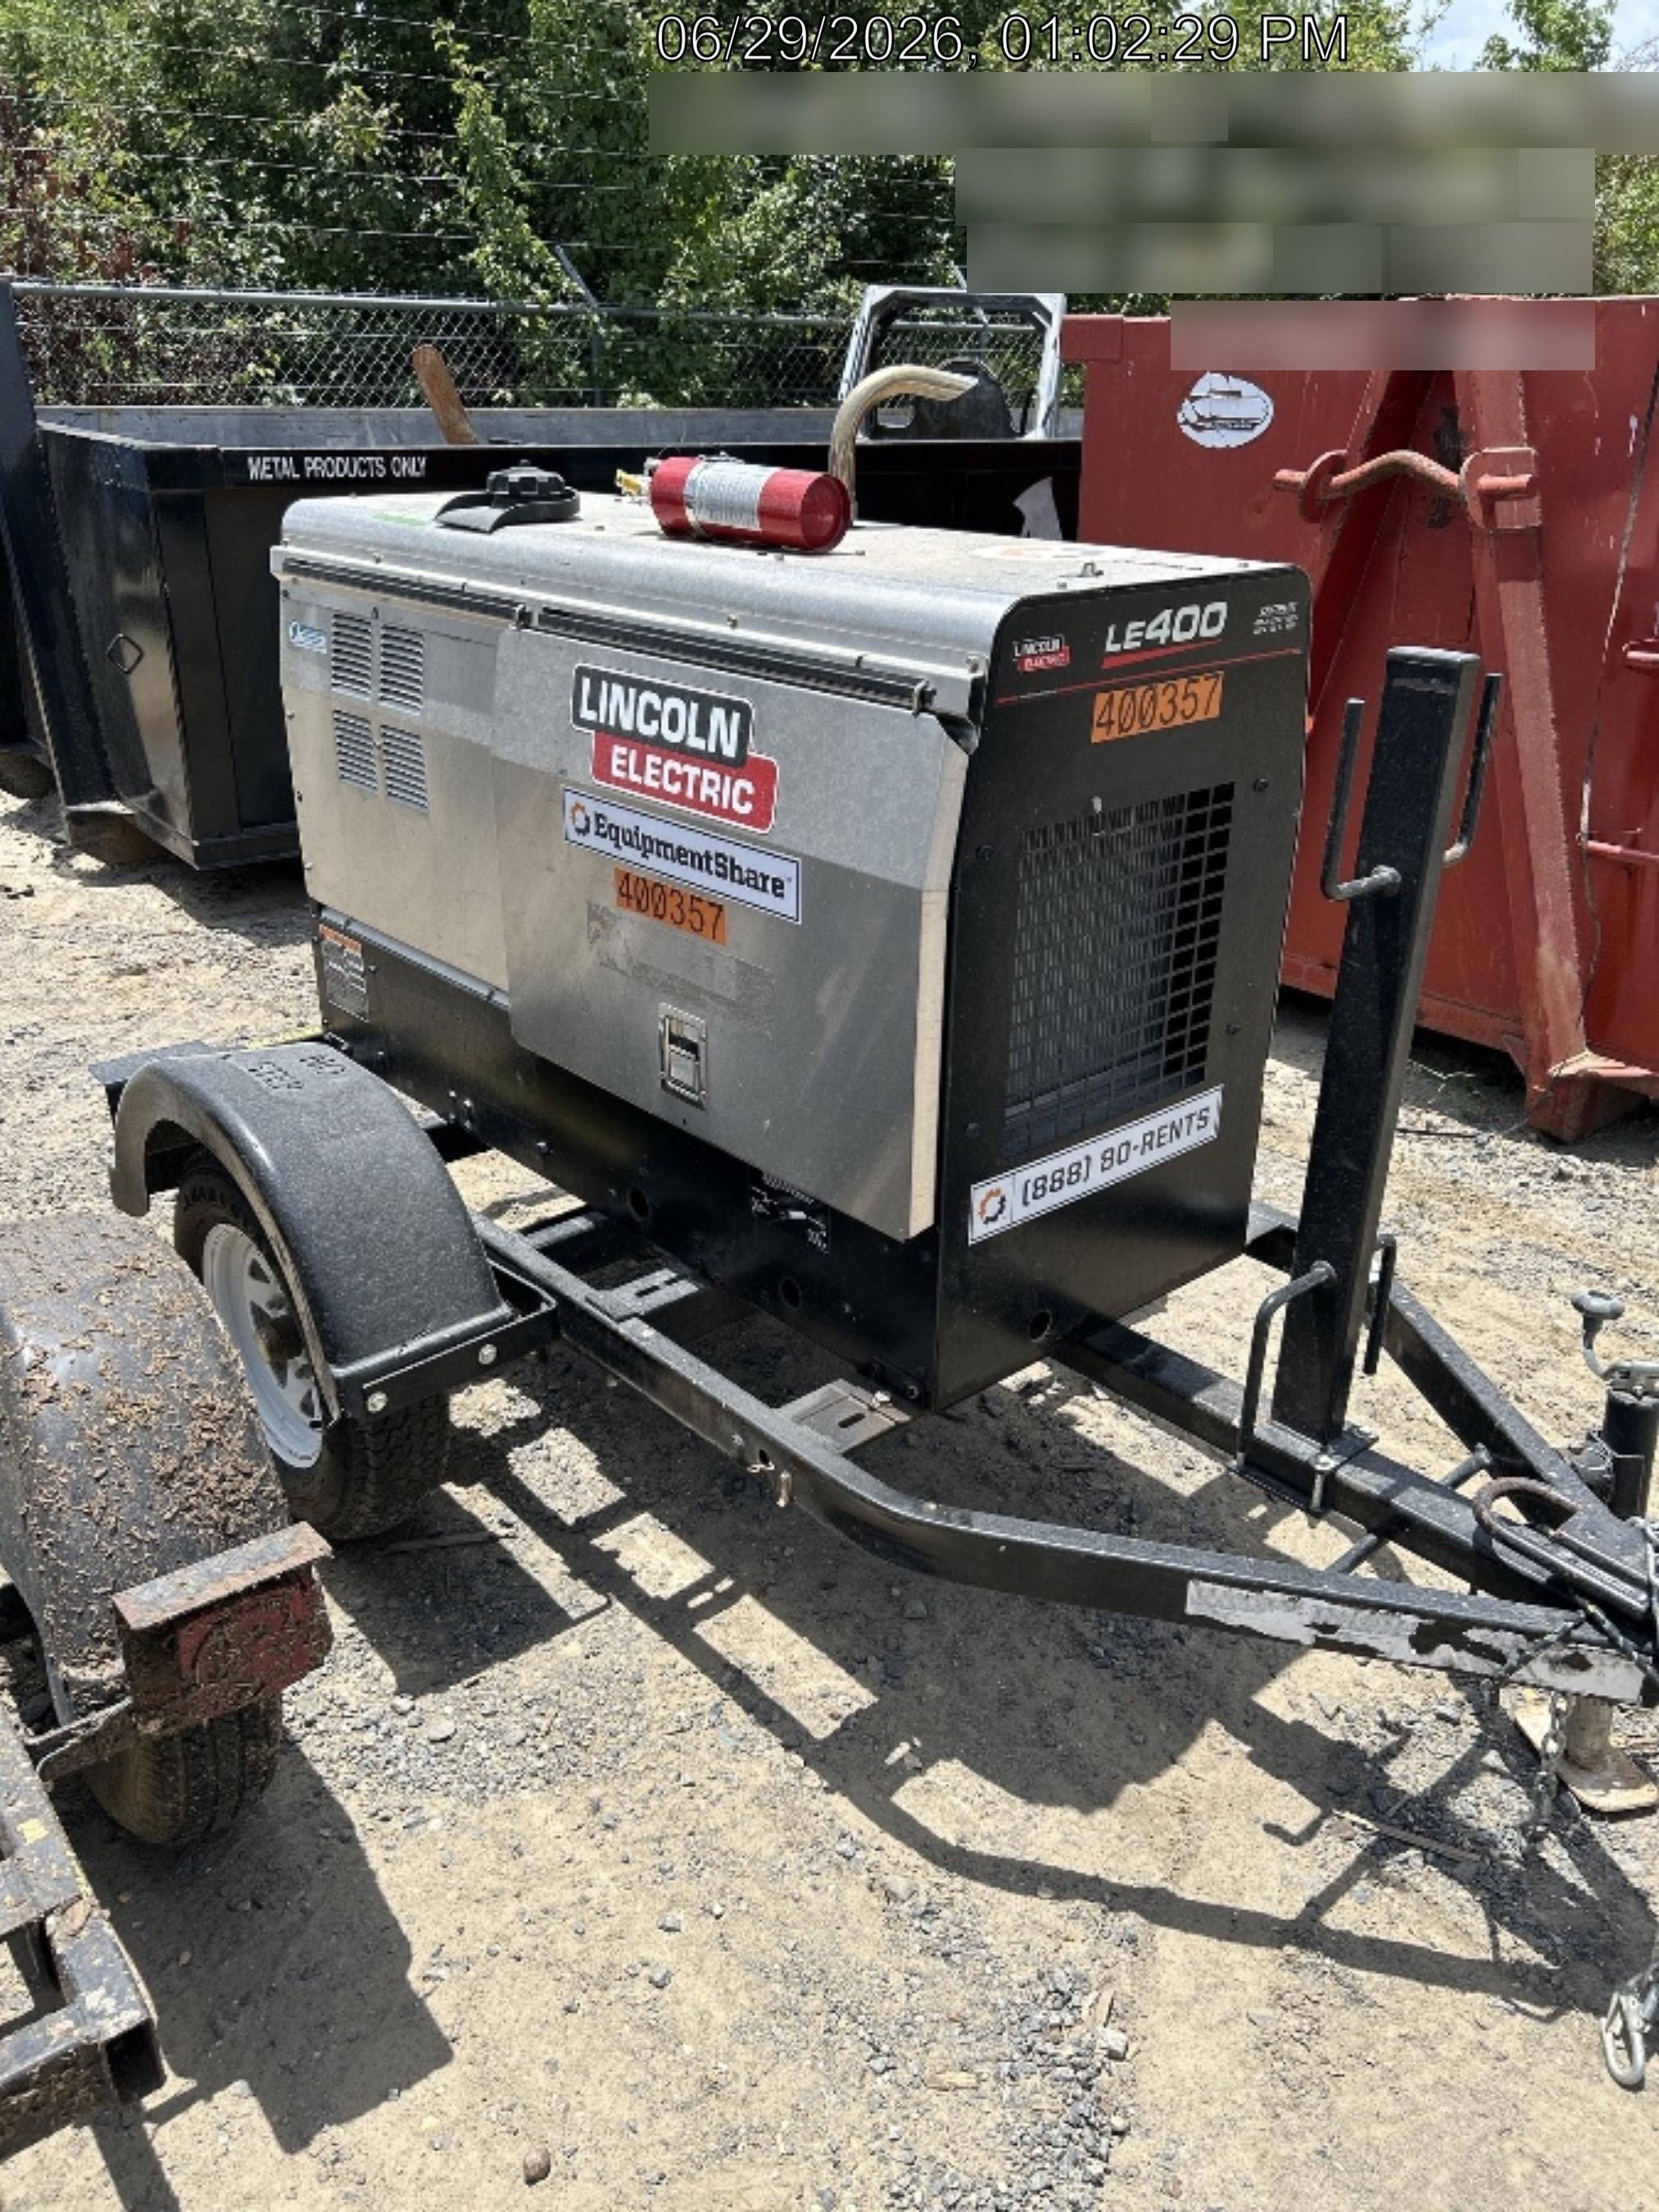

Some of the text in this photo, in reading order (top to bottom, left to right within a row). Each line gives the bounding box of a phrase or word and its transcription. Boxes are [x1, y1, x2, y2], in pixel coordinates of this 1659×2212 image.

[247, 456, 426, 480] METAL PRODUCTS ONLY
[1105, 601, 1227, 652] LE400
[579, 676, 741, 758] LINCOLN
[1095, 673, 1221, 735] 400357
[611, 744, 755, 814] ELECTRIC
[594, 811, 785, 899] EquipmentShare
[618, 872, 724, 940] 400357
[1022, 1106, 1211, 1207] (888) 80-RENTS
